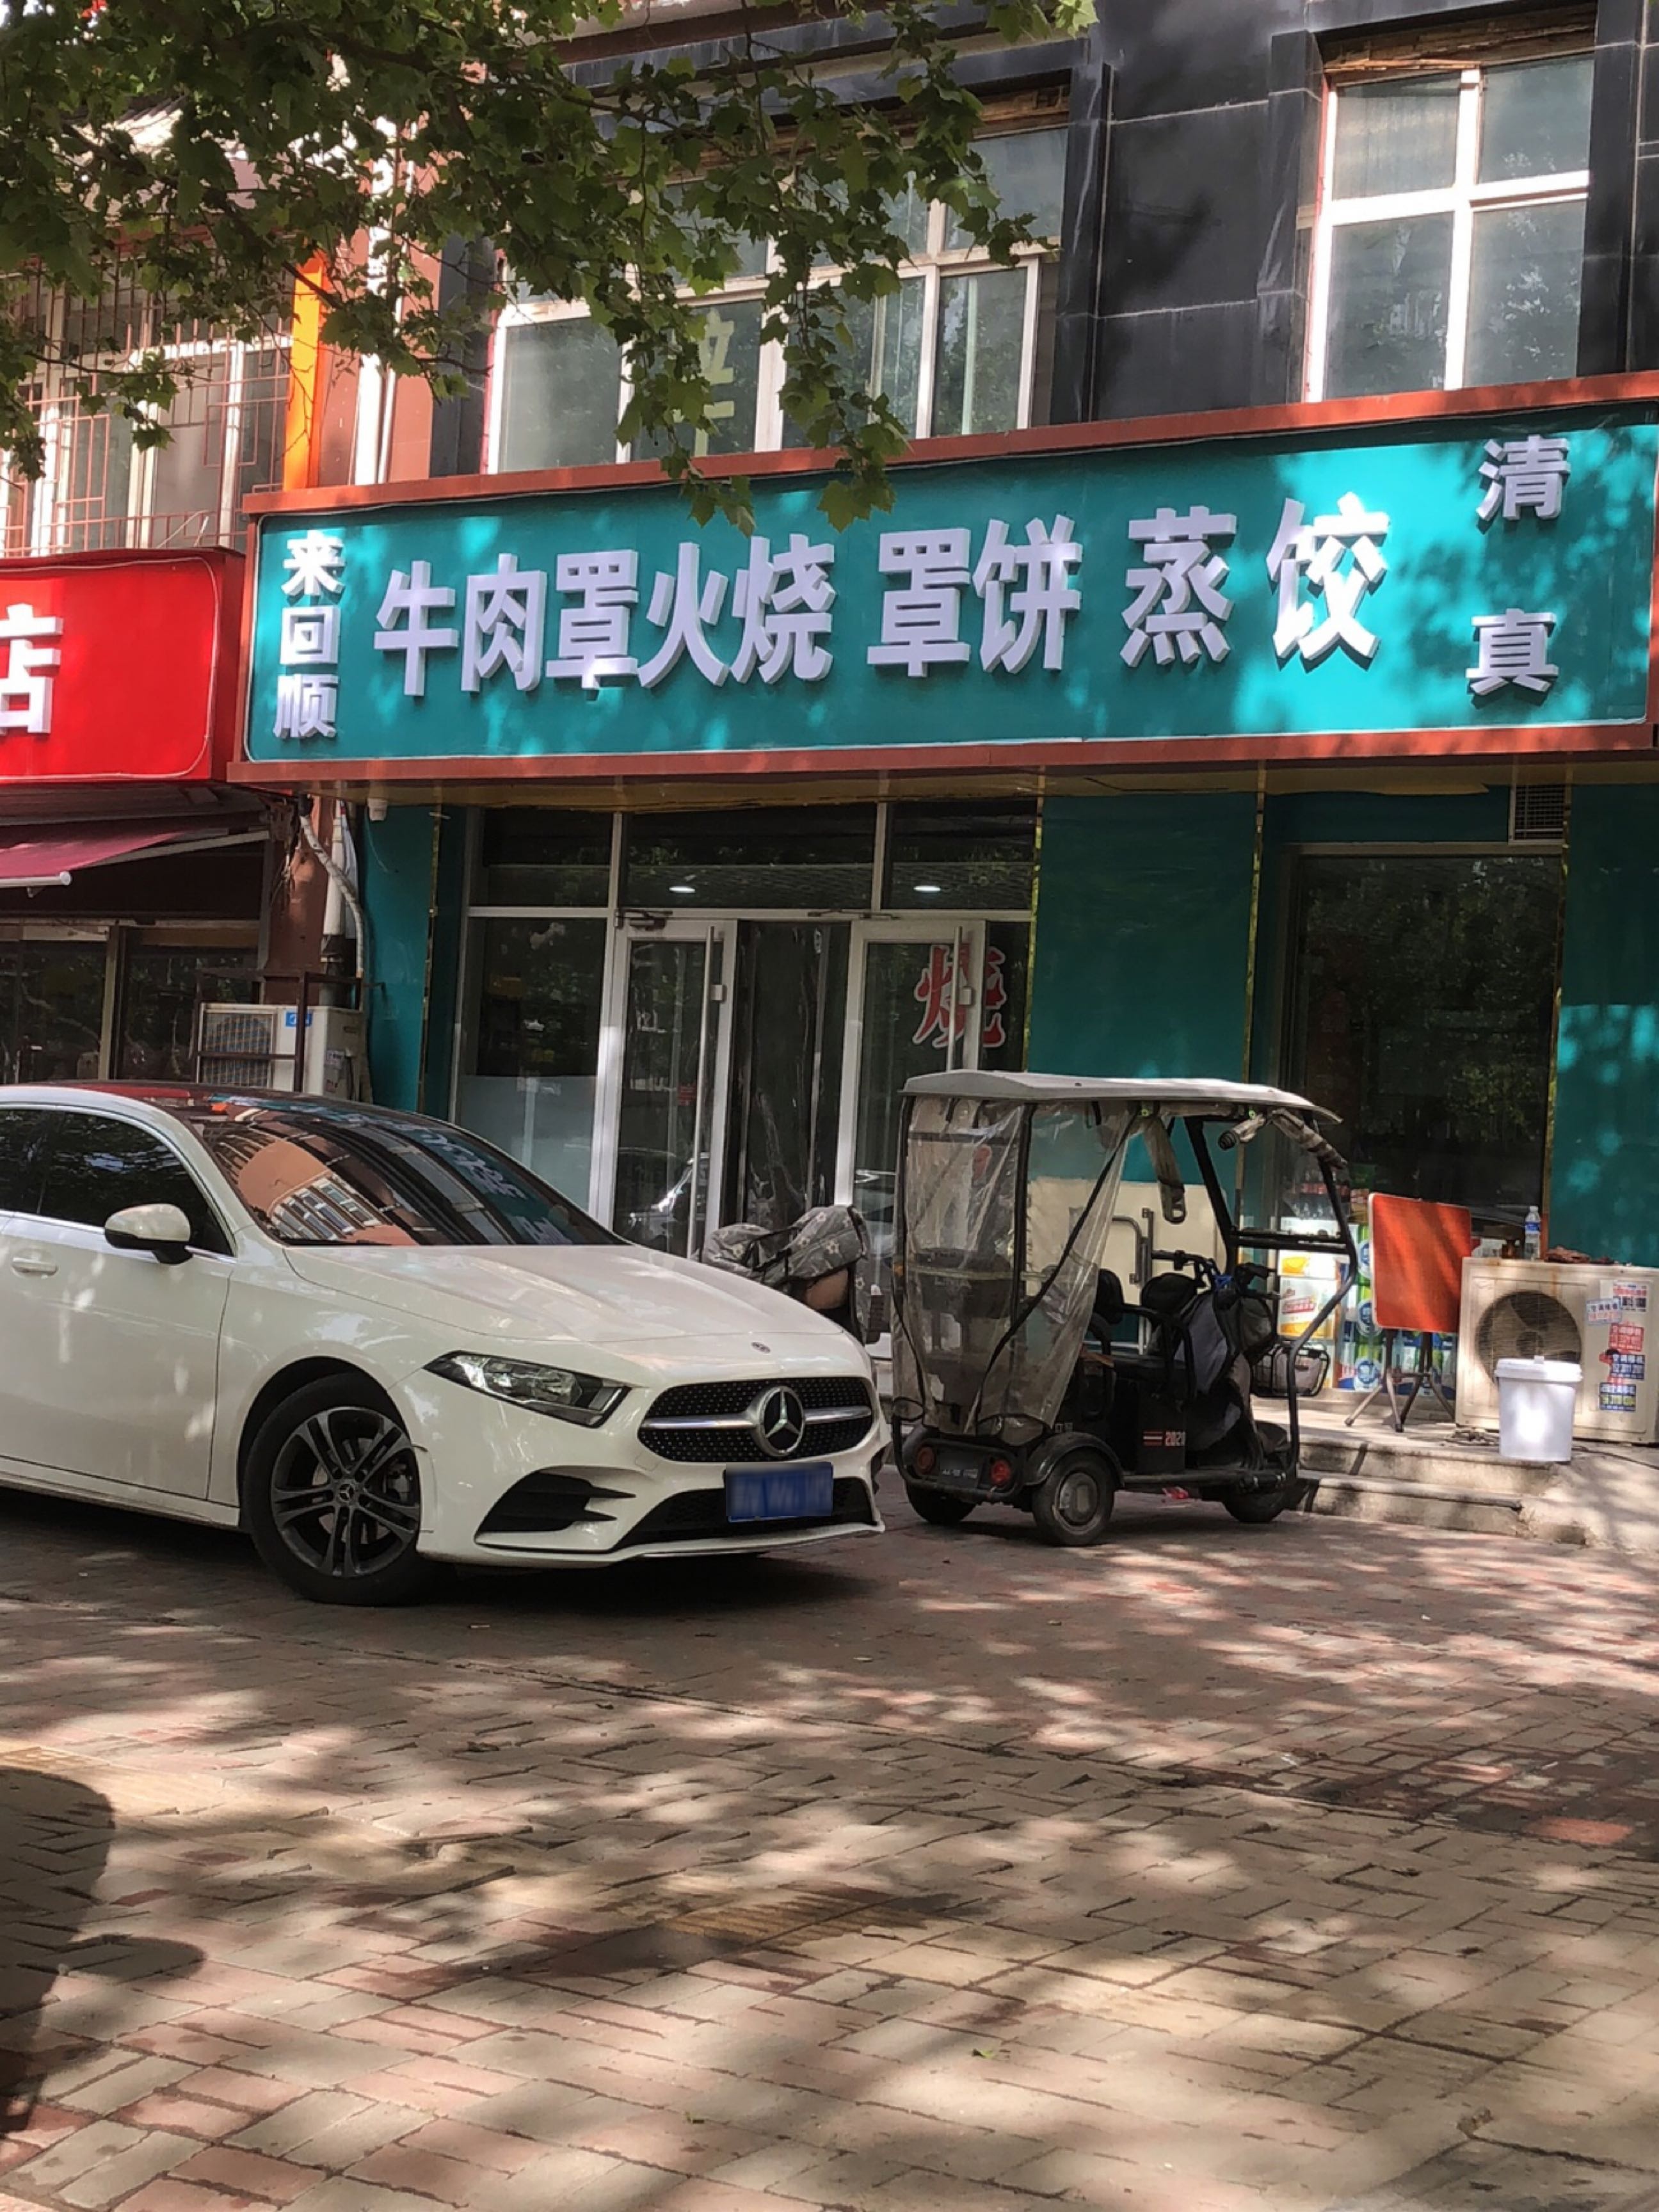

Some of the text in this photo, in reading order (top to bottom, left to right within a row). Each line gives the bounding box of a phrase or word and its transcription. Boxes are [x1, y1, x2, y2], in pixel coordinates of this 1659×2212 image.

[0, 603, 63, 734] 店
[273, 529, 346, 740] 来回顺
[374, 492, 1390, 697] 牛肉罩火烧 罩饼 蒸饺
[1465, 435, 1571, 698] 清真
